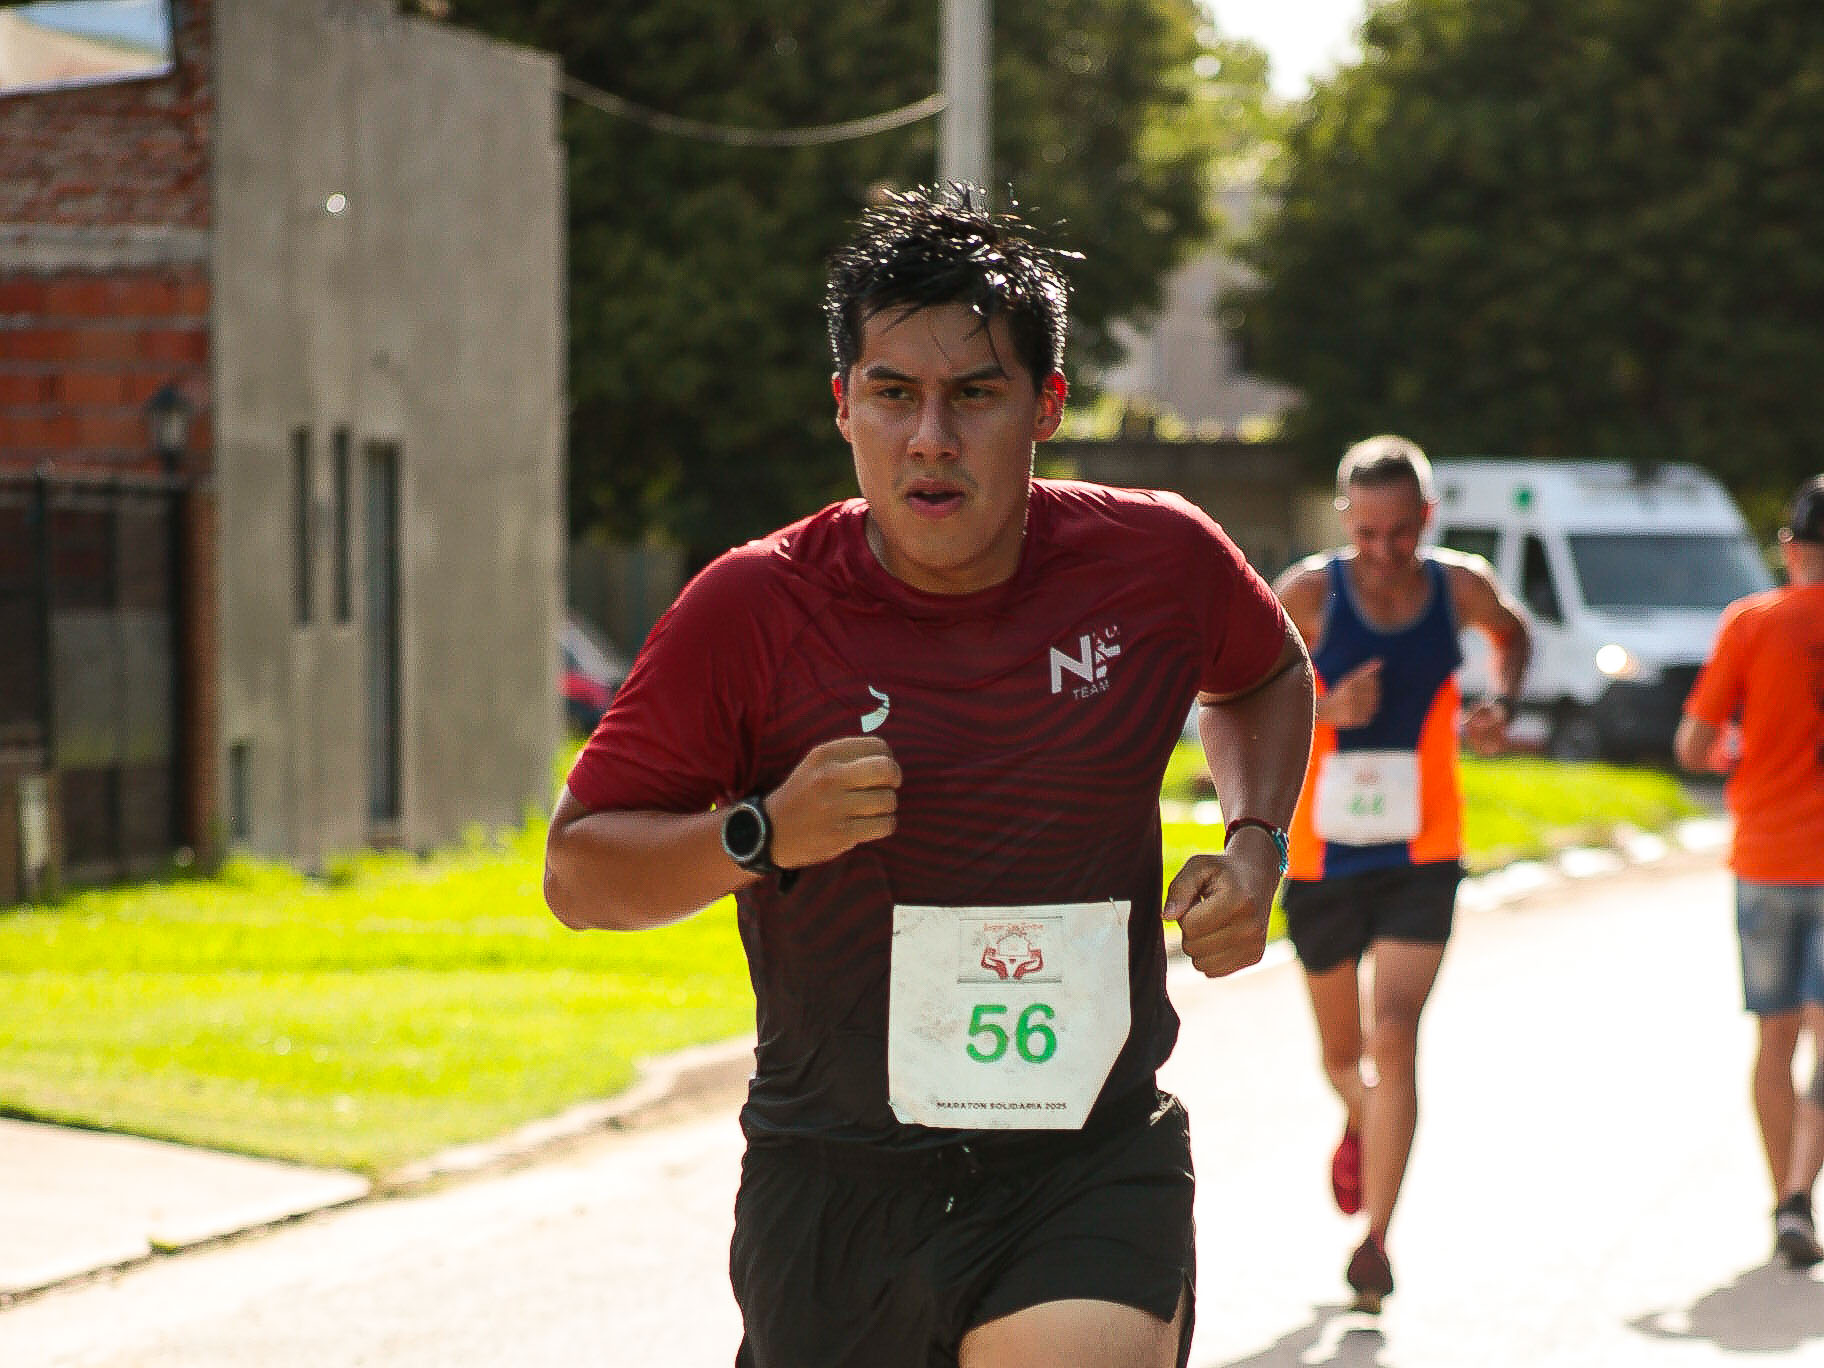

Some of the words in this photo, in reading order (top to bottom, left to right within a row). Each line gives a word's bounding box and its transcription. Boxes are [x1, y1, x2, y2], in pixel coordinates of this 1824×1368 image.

[966, 1003, 1057, 1064] 56
[936, 1102, 987, 1110] MARATON
[989, 1102, 1042, 1110] SOLIDARIA
[1045, 1102, 1067, 1110] 2025
